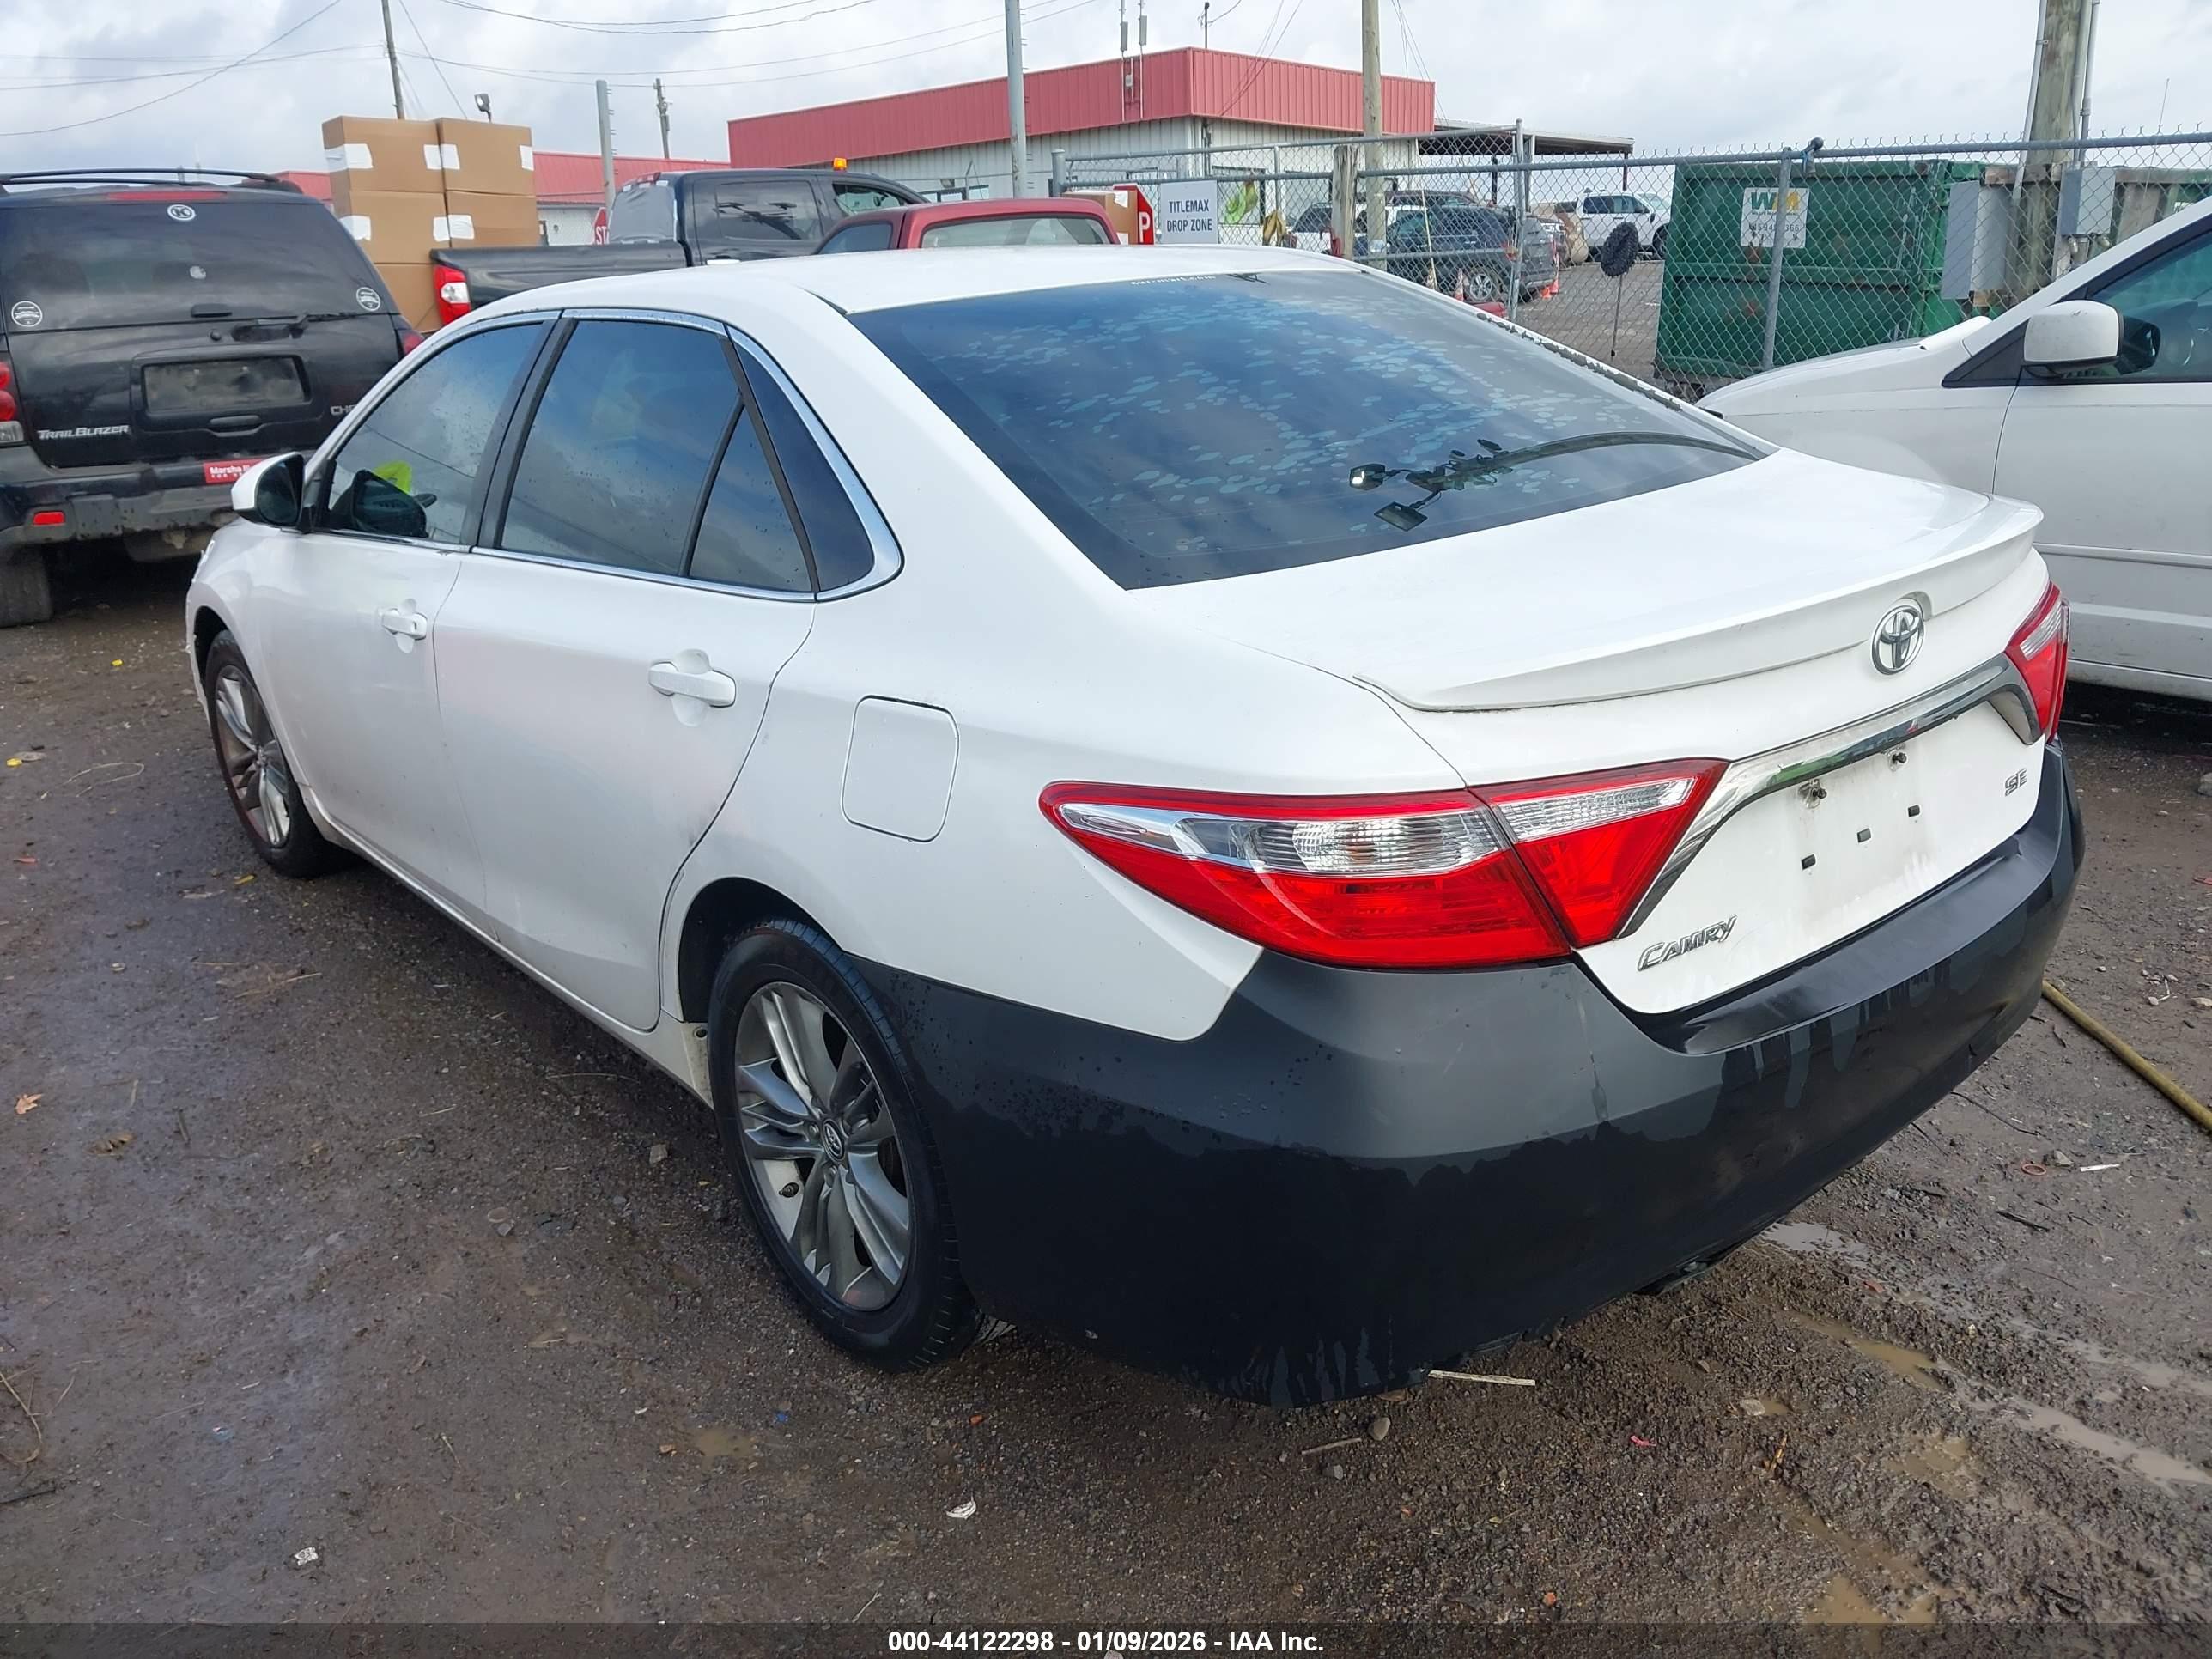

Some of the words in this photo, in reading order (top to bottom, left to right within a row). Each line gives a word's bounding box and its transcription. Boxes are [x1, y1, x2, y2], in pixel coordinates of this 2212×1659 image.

[1169, 199, 1210, 213] TITLEMAX
[1167, 219, 1188, 232] DROP
[1190, 218, 1212, 232] ZONE
[2005, 768, 2027, 797] SE
[1638, 915, 1737, 971] CAMRY
